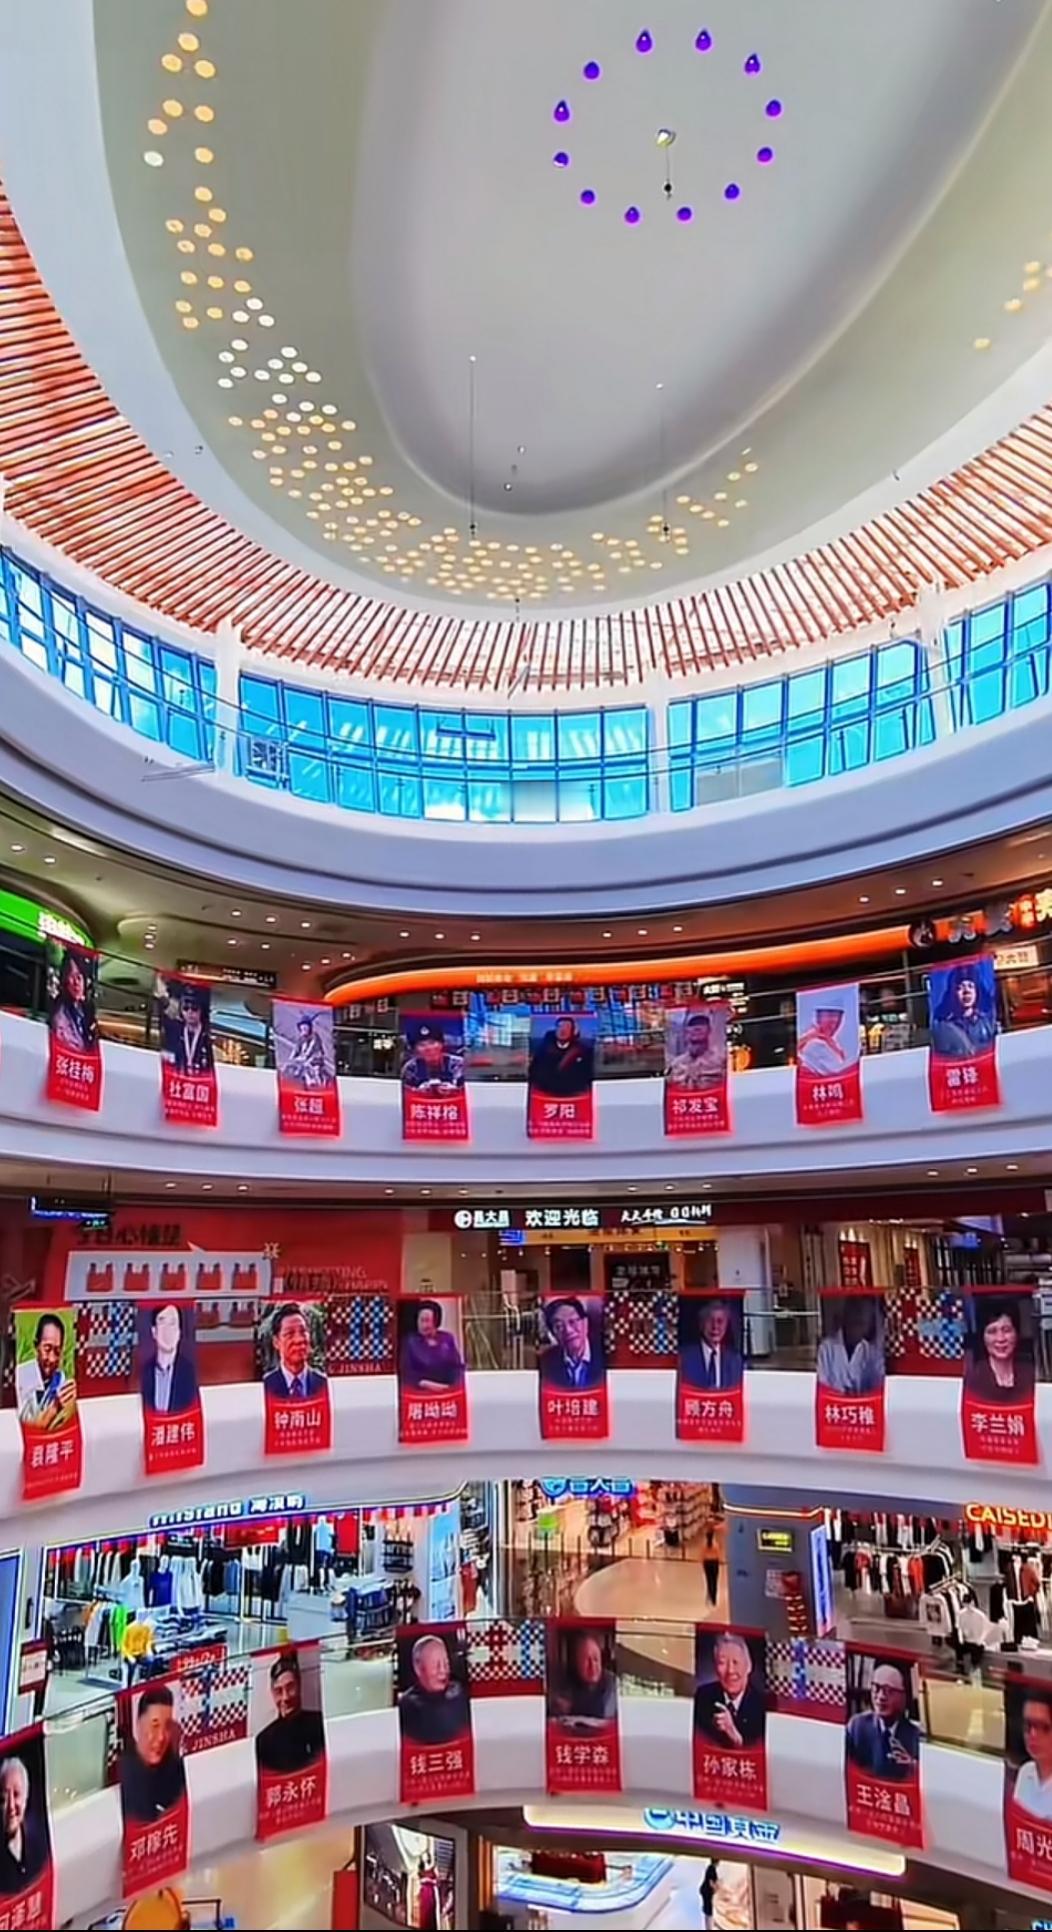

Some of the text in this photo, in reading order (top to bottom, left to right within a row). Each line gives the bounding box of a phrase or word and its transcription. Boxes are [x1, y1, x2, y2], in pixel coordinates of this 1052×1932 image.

[543, 1102, 576, 1119] 罗阳
[671, 1096, 719, 1114] 祁发宝
[525, 1208, 599, 1227] 欢迎光临
[407, 1401, 458, 1420] 屠呦呦
[547, 1398, 600, 1416] 叶培建
[684, 1398, 734, 1418] 顾方舟
[825, 1405, 875, 1426] 林巧稚
[274, 1408, 321, 1430] 钟南山
[970, 1412, 1025, 1436] 李兰娟
[151, 1422, 196, 1448] 潘建伟
[192, 1729, 236, 1751] JINSHA
[409, 1750, 464, 1775] 钱三强
[555, 1744, 610, 1765] 钱学森
[703, 1753, 758, 1782] 孙家栋
[265, 1774, 317, 1809] 郭永怀
[856, 1783, 911, 1816] 王淦昌
[129, 1823, 179, 1862] 邓稼先
